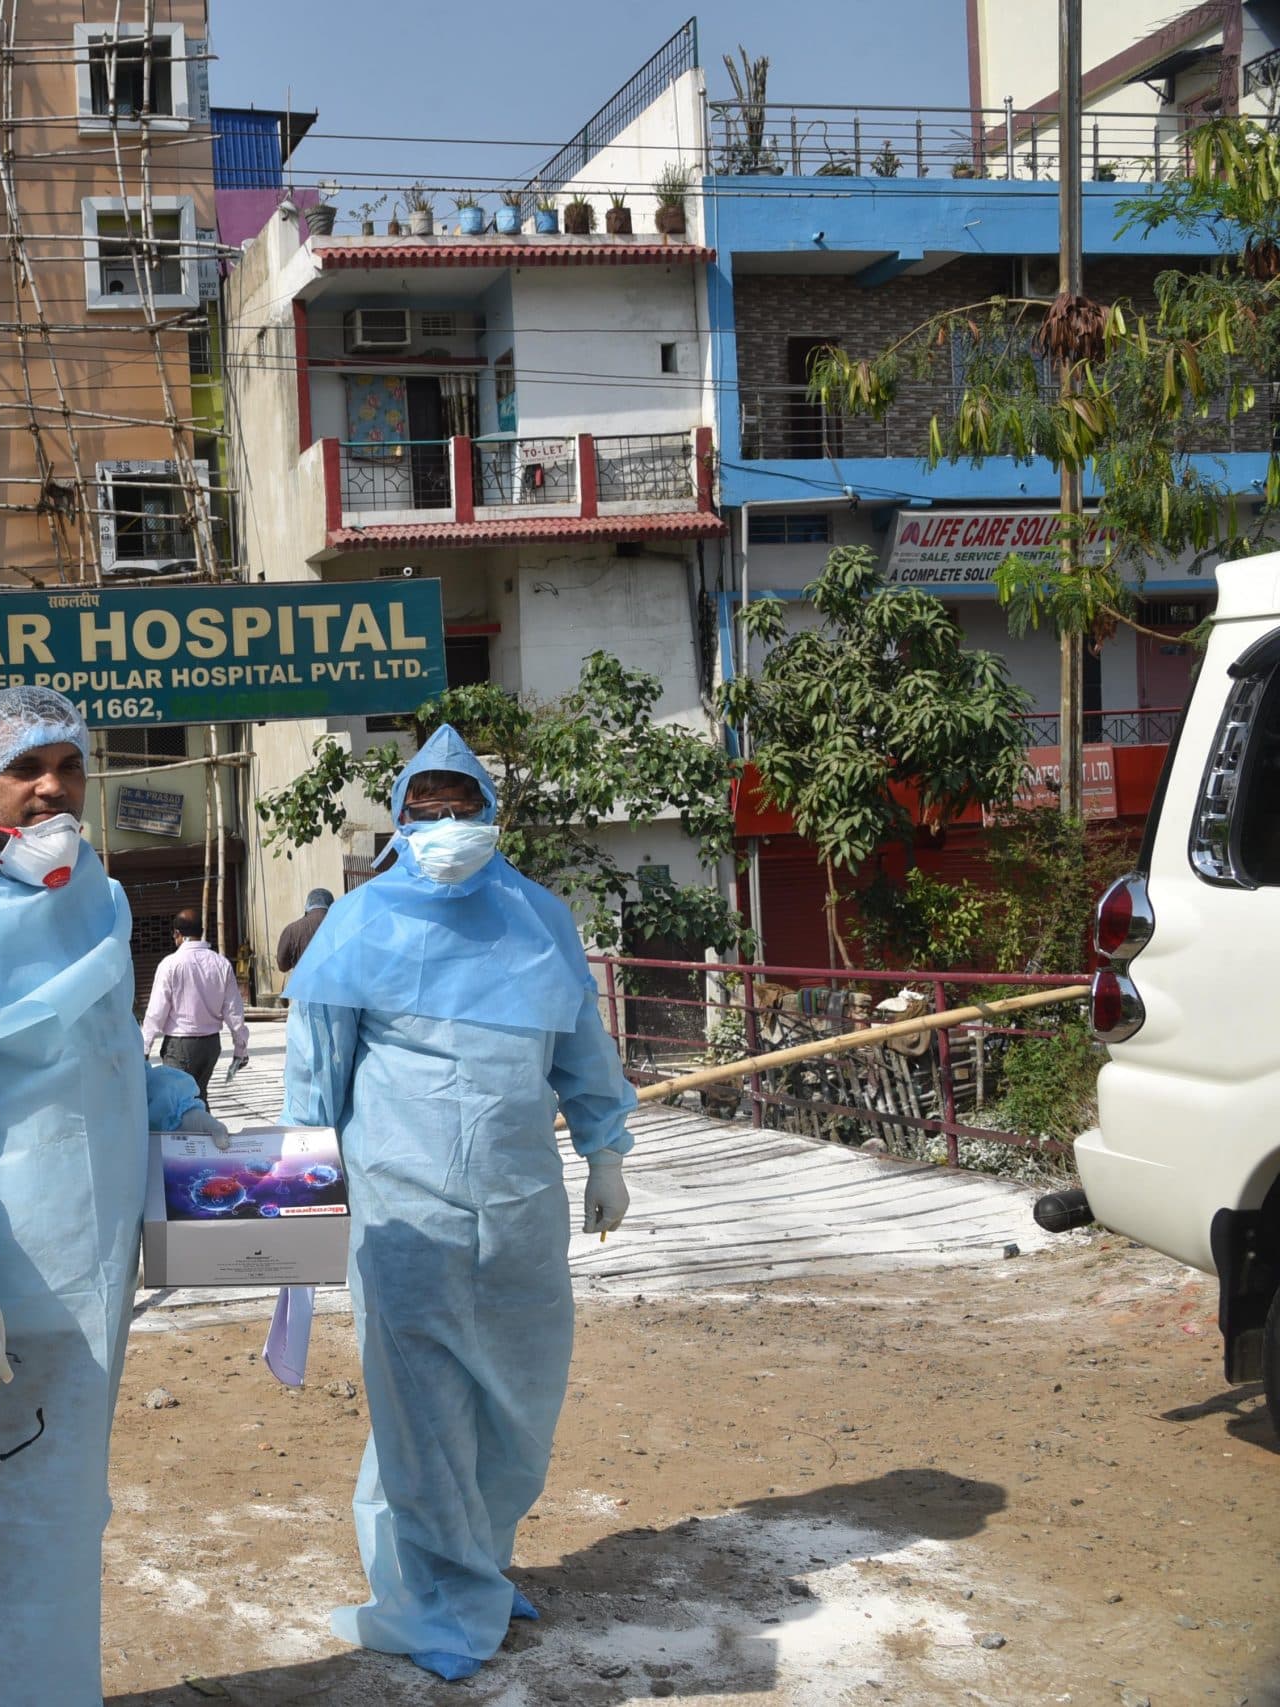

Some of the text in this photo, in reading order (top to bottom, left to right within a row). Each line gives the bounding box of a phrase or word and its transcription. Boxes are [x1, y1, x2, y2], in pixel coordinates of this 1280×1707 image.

[523, 445, 563, 458] TO-LET
[920, 518, 963, 547] LIFE
[962, 517, 1014, 546] CARE
[920, 552, 950, 563] SALE,
[954, 551, 1001, 562] SERVICE
[889, 569, 898, 582] A
[901, 567, 963, 582] COMPLETE
[48, 591, 101, 609] सकलदीप
[80, 602, 426, 663] HOSPITAL
[35, 669, 163, 692] POPULAR
[171, 663, 303, 688] HOSPITAL
[311, 660, 365, 682] PVT.
[374, 658, 428, 680] LTD.
[76, 697, 163, 721] 11662,
[1091, 761, 1113, 782] LTD.
